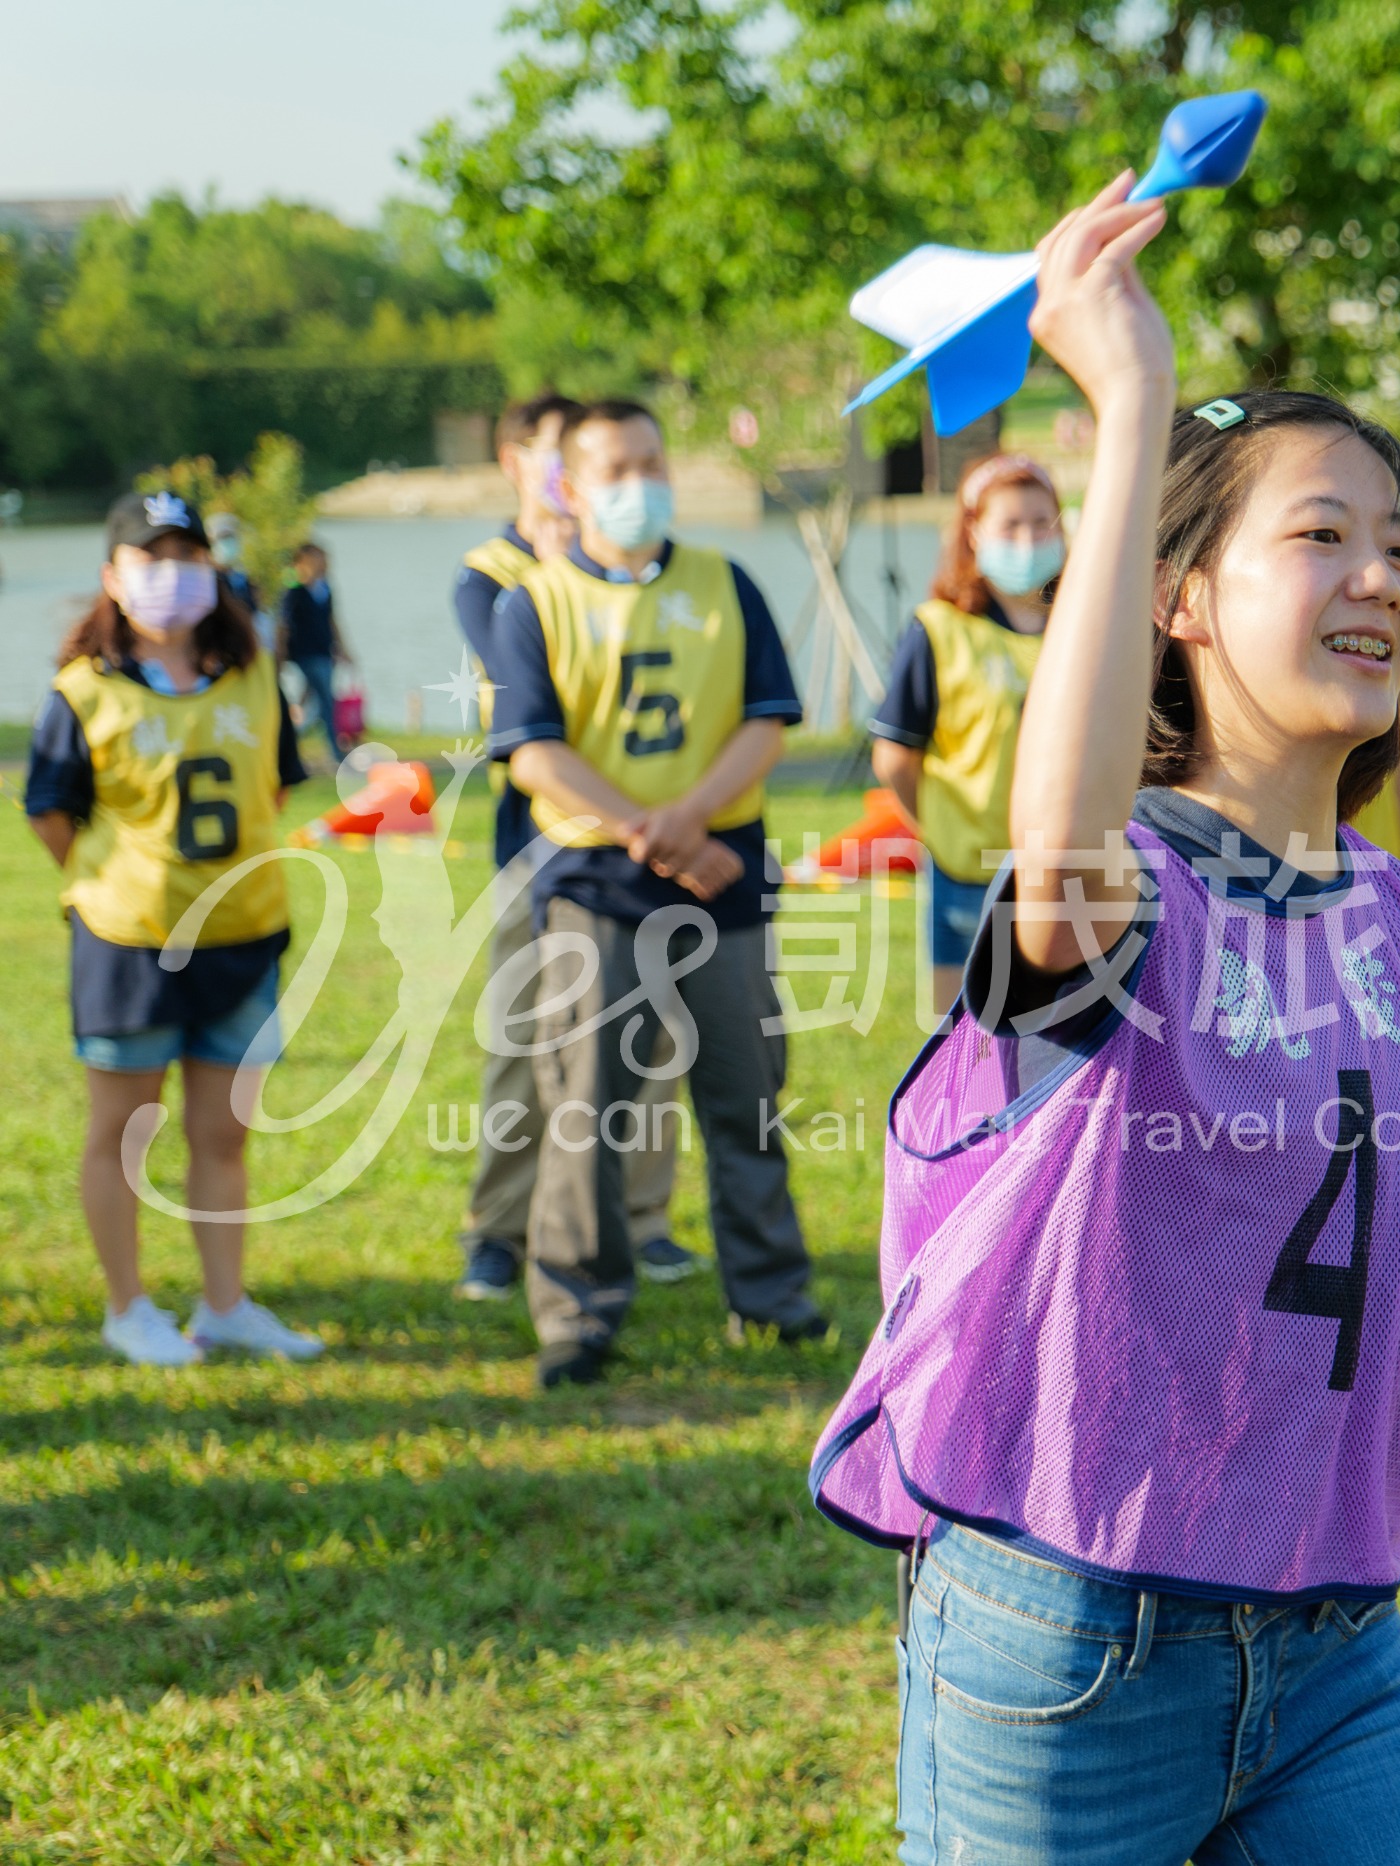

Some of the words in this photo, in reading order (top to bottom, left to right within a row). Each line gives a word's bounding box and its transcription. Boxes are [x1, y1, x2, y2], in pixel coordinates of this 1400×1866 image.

[620, 651, 685, 756] 5
[176, 756, 238, 860] 6
[1262, 1069, 1378, 1392] 4
